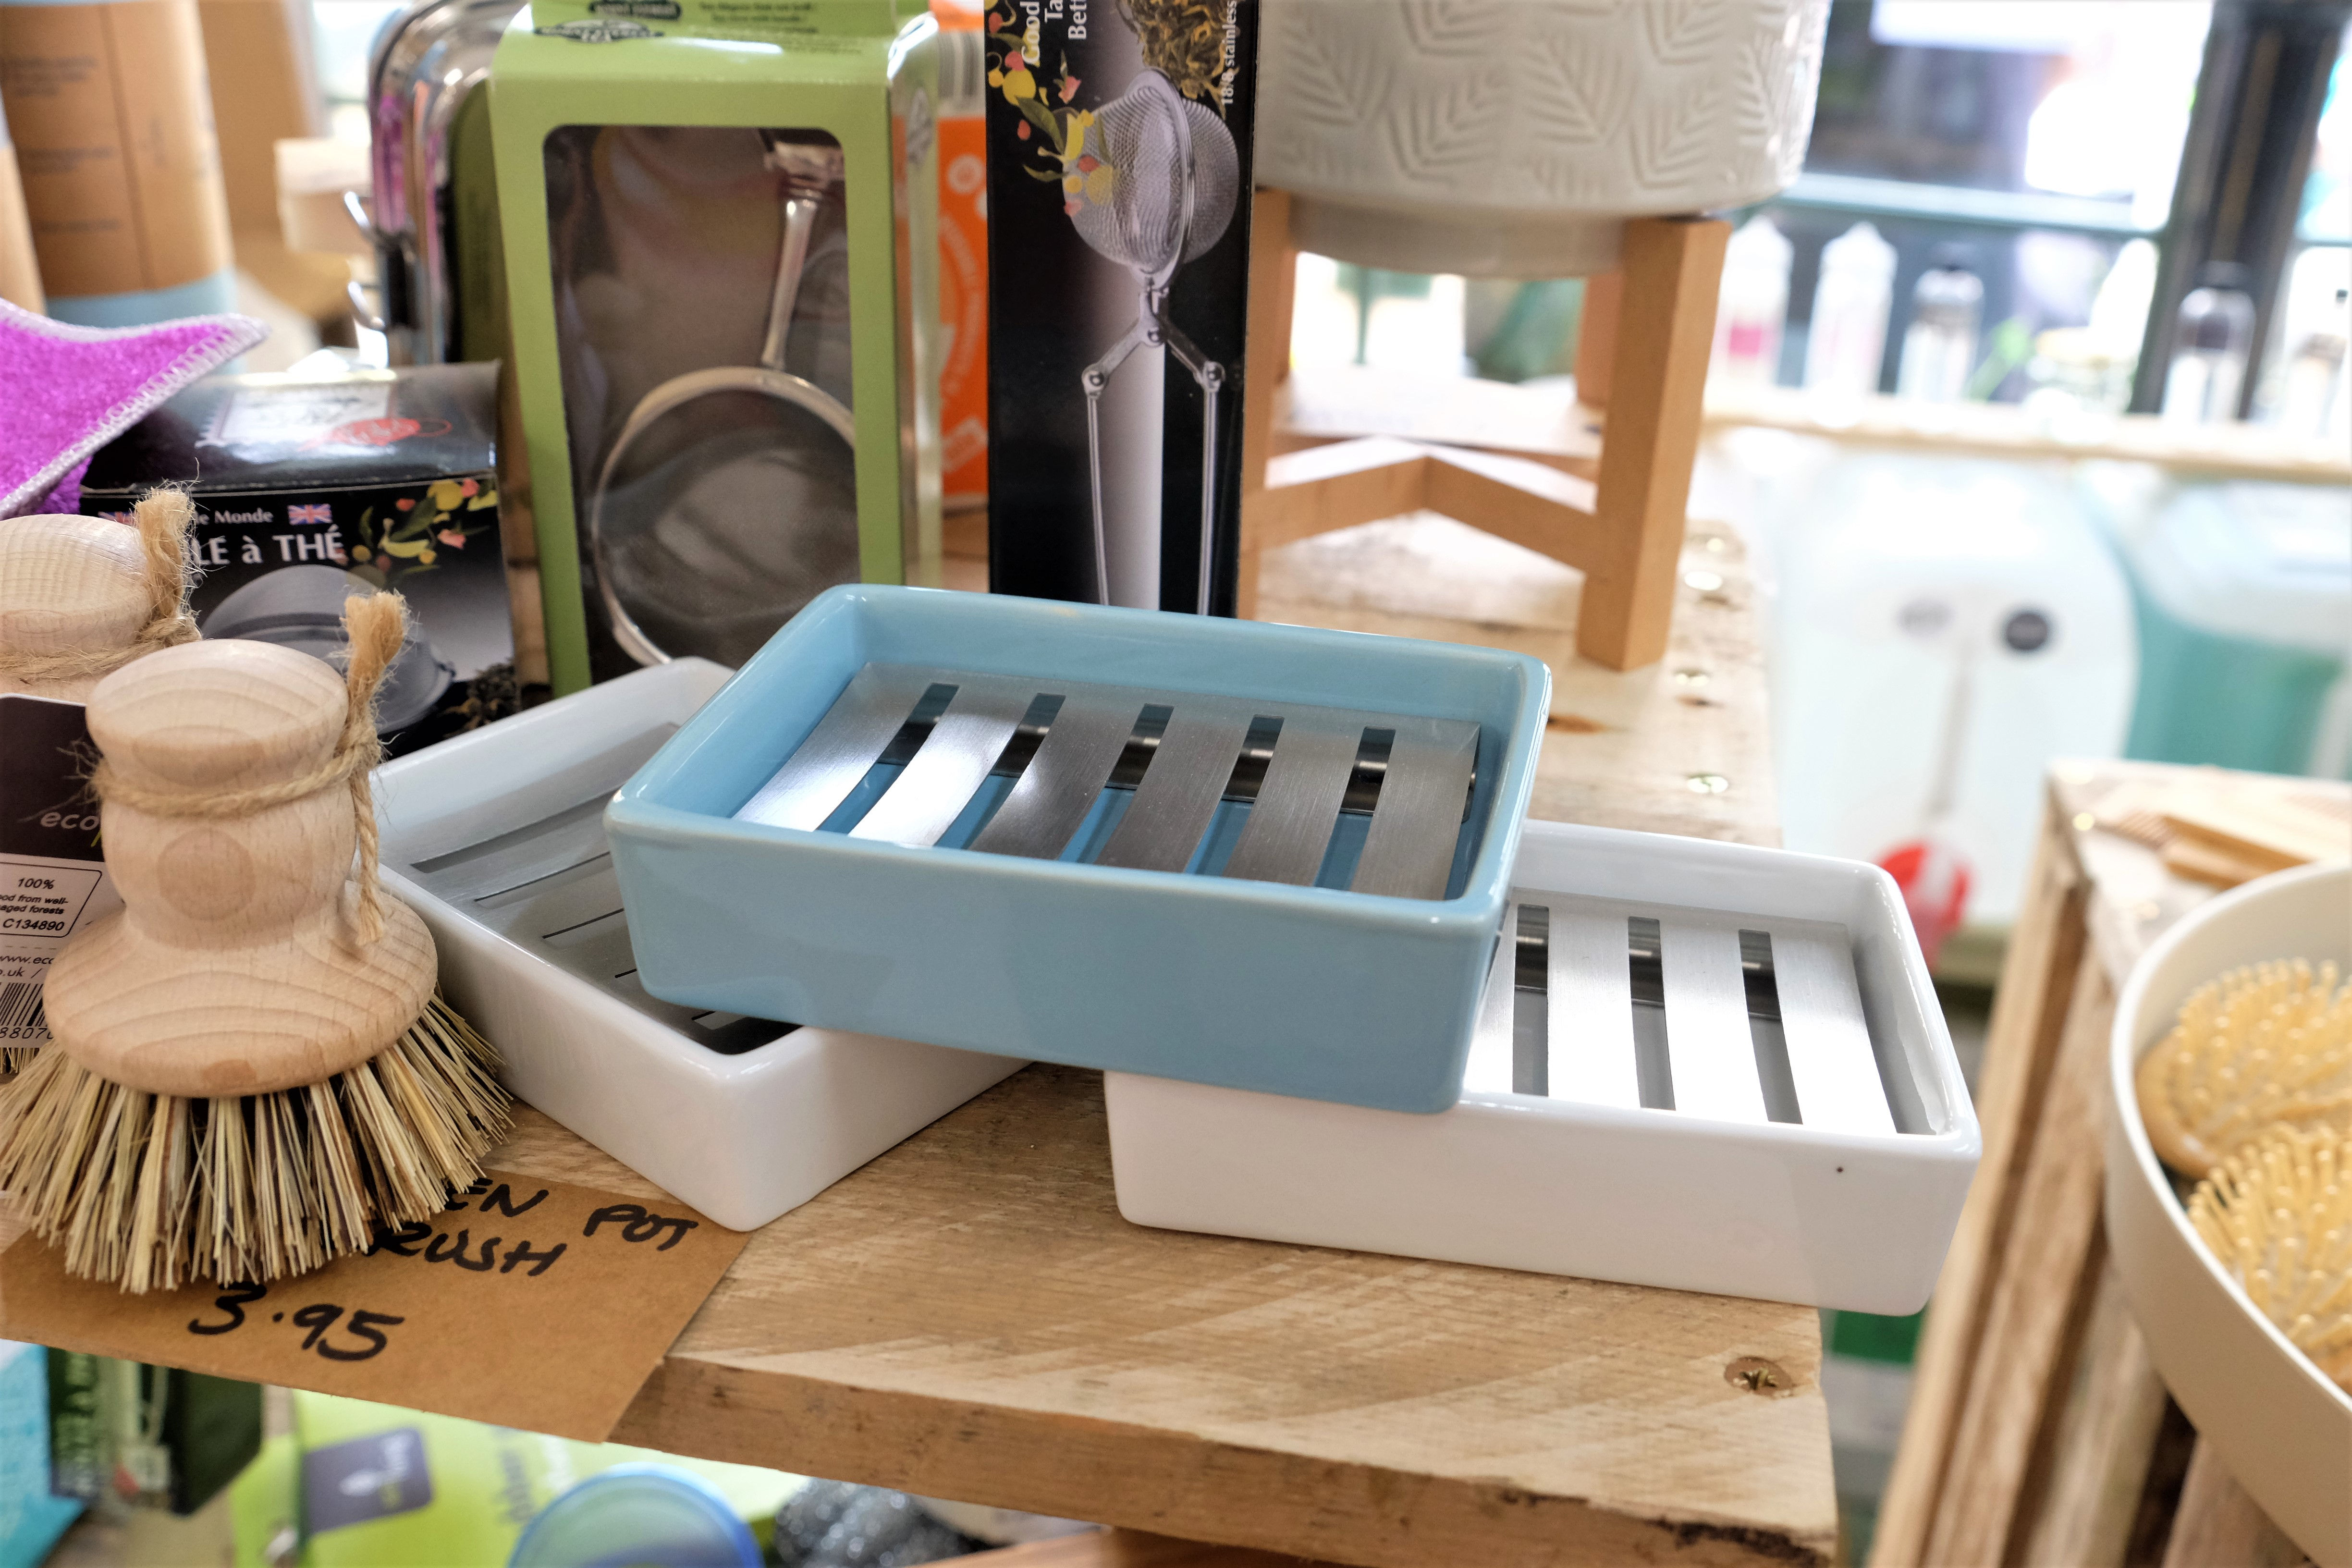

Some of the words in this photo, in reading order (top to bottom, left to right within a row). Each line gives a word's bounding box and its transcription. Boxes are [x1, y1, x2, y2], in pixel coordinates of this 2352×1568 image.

[1019, 1, 1040, 64] Good
[1067, 0, 1087, 40] Bet
[1222, 0, 1237, 67] stainless
[214, 507, 274, 524] Monde
[192, 535, 231, 565] LE
[241, 535, 264, 564] à
[272, 524, 344, 562] THÉ
[40, 812, 101, 838] eco
[18, 878, 55, 890] 100%
[18, 894, 41, 903] from
[0, 905, 28, 913] aged
[29, 905, 65, 915] forests
[2, 918, 65, 931] C134890
[443, 1177, 550, 1217] EN
[583, 1203, 699, 1251] POT
[360, 1221, 568, 1276] RUSH
[187, 1281, 404, 1362] 3.95
